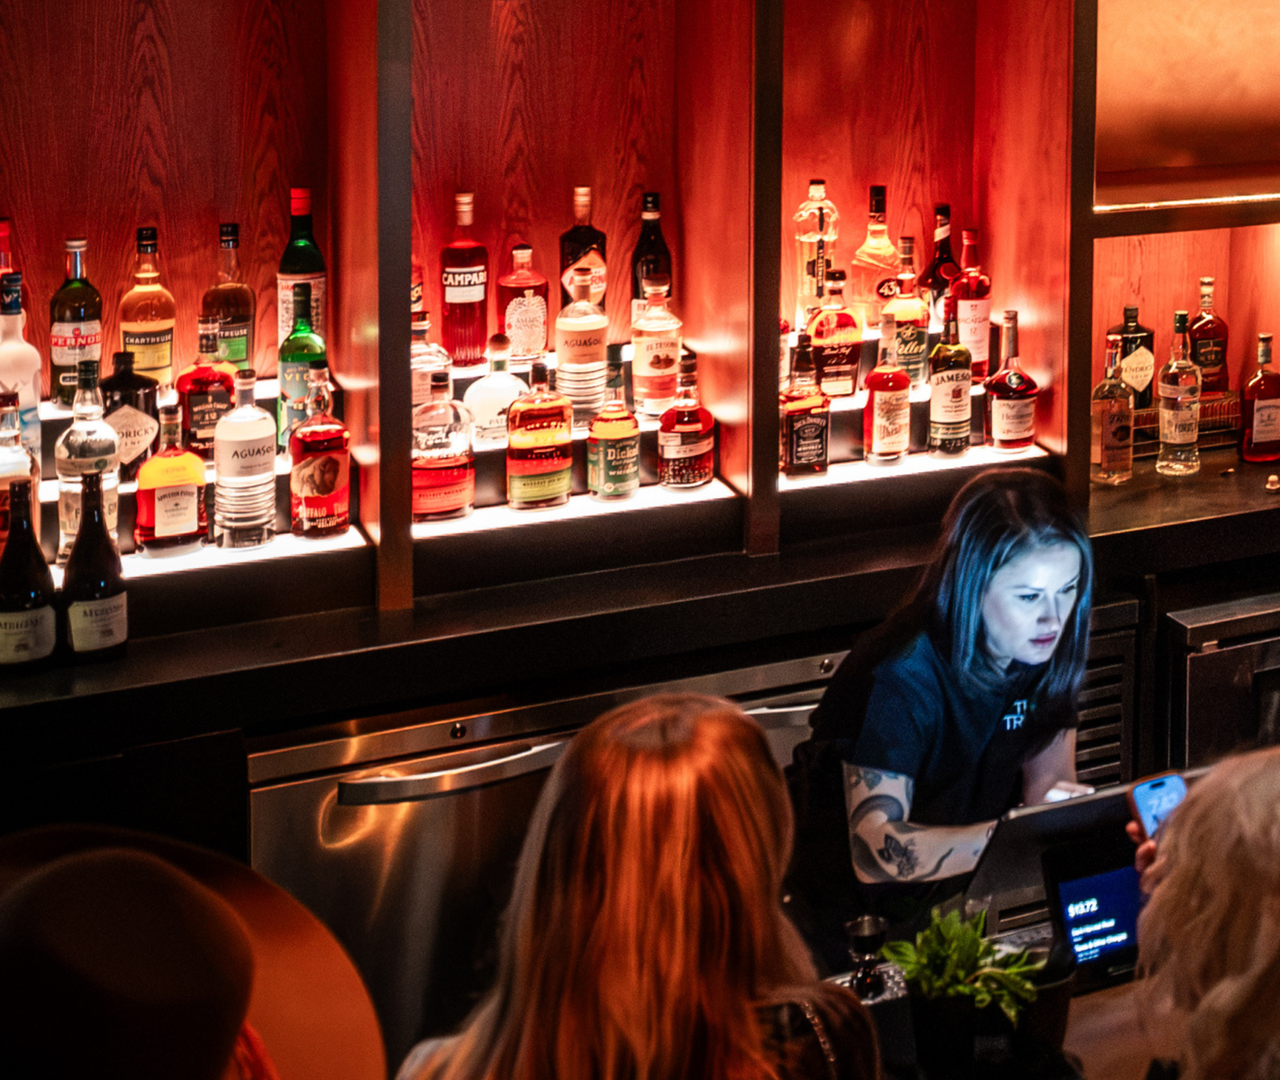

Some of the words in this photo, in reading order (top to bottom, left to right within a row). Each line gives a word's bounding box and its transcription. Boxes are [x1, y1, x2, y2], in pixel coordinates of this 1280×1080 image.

[442, 271, 487, 286] CAMPARI
[879, 280, 897, 295] 43
[51, 333, 101, 347] PERNOD
[125, 334, 172, 344] CHARTREUSE
[219, 328, 249, 338] TREUSE
[935, 371, 970, 386] JAMESO
[117, 426, 155, 440] DRICK'S
